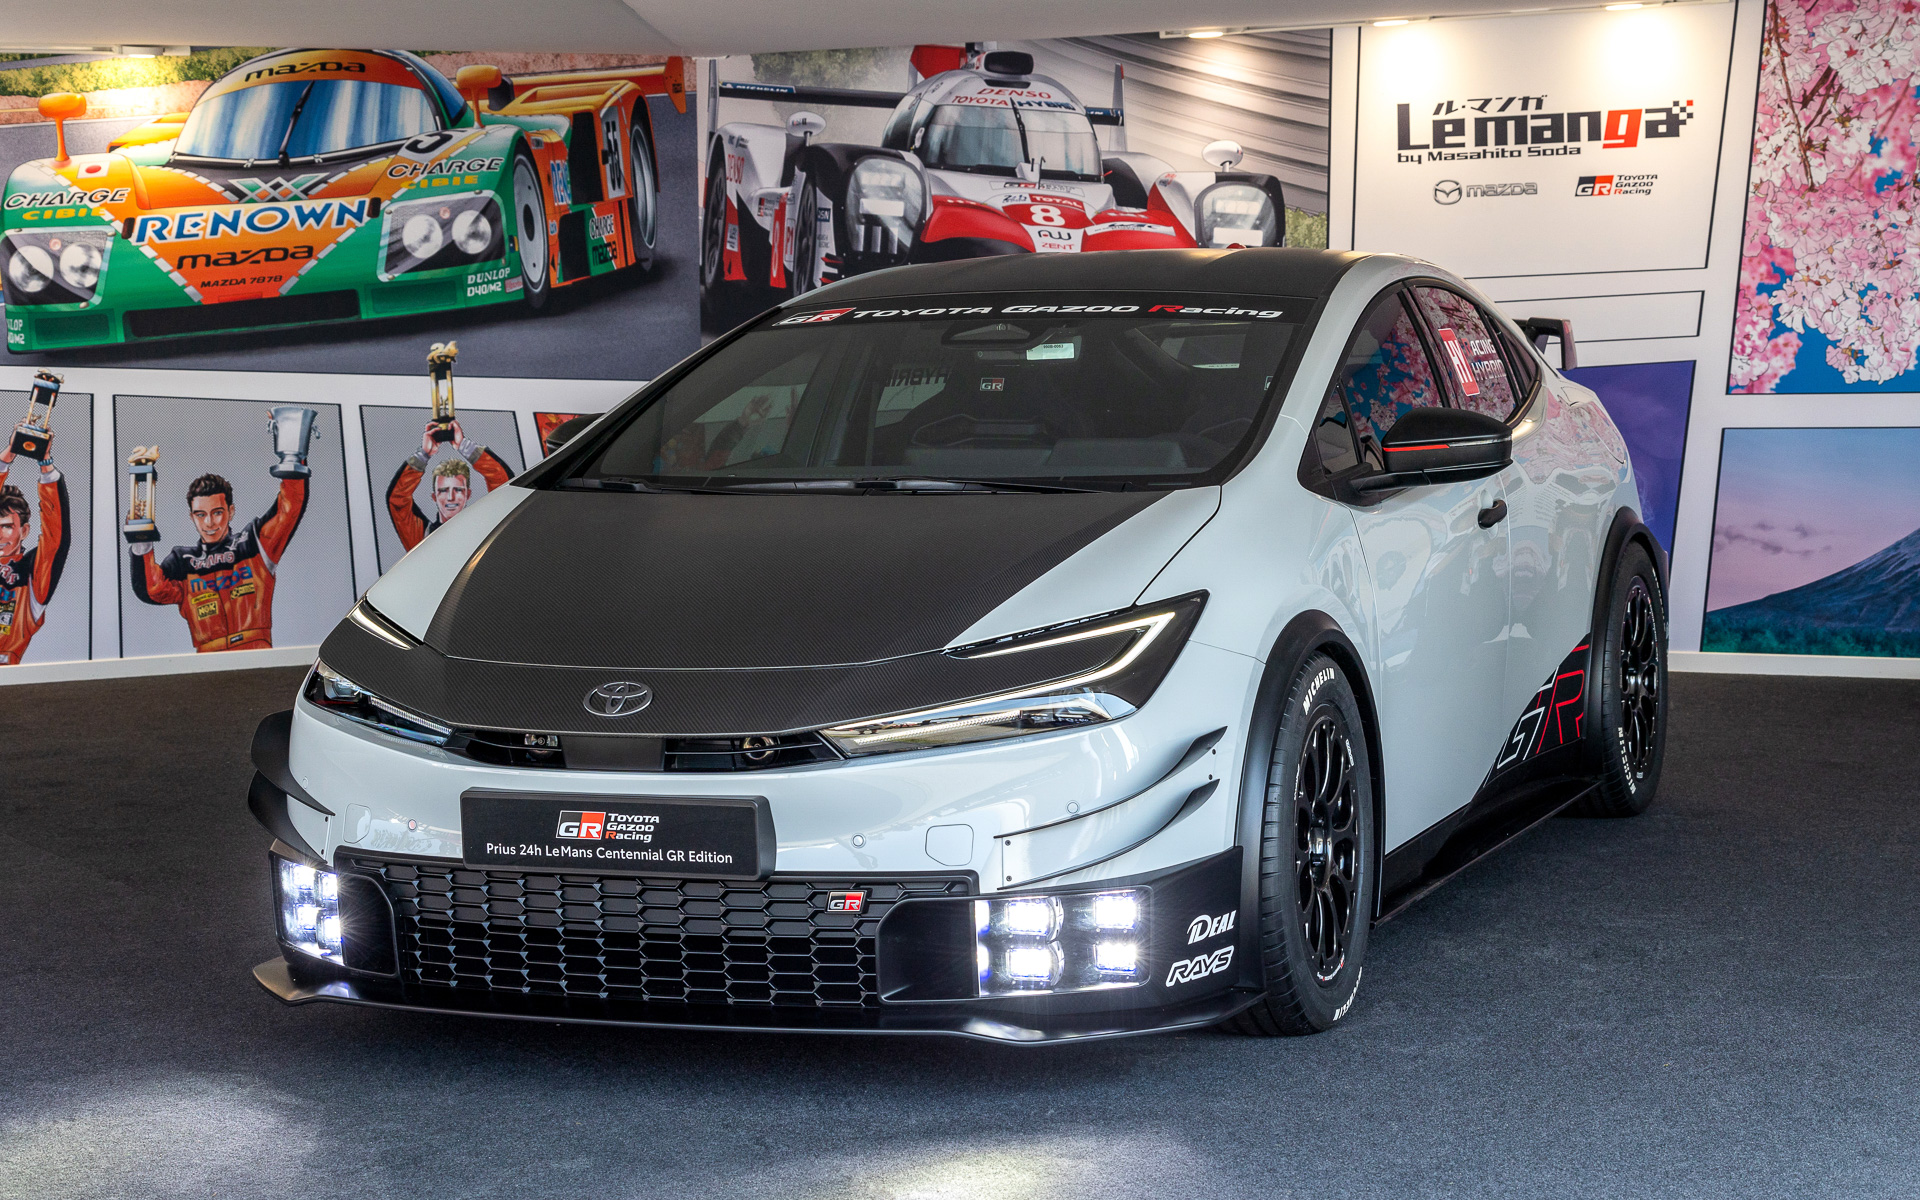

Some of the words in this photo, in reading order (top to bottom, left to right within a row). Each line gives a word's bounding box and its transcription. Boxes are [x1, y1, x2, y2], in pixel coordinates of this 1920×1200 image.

[244, 62, 366, 82] mazda
[976, 87, 1052, 100] DENSO
[951, 95, 1009, 107] TOYOTA
[1016, 100, 1076, 112] HYBRID
[1432, 95, 1548, 116] ル・マンガ
[1397, 153, 1422, 165] by
[1427, 148, 1522, 162] Masahito
[1527, 146, 1582, 158] Soda
[387, 157, 504, 178] CHARGE
[400, 175, 479, 189] CIBIE
[1466, 182, 1538, 198] mazda
[6, 188, 129, 208] CHARGE
[1031, 195, 1083, 209] TOTAL
[22, 207, 106, 221] CIBIE
[133, 199, 369, 245] RENOWN
[1030, 205, 1066, 226] 8
[589, 213, 614, 240] CHARGE
[176, 245, 314, 270] mazda
[200, 276, 247, 288] MAZDA
[466, 267, 511, 285] DUNLOP
[852, 306, 993, 319] TOYOTA
[1001, 304, 1140, 314] GAZOO
[1148, 304, 1284, 319] Racing
[1461, 338, 1497, 356] RACING
[1471, 359, 1507, 381] HYBRID
[1302, 667, 1335, 716] MICHELIN
[607, 812, 660, 823] TOYOTA
[606, 822, 655, 832] GAZOO
[605, 831, 653, 843] Racing
[486, 843, 517, 855] Prius
[519, 844, 543, 857] 24h
[596, 847, 664, 863] Centennial
[666, 849, 686, 863] GR
[688, 850, 734, 864] Edition
[1165, 944, 1235, 988] RAYS
